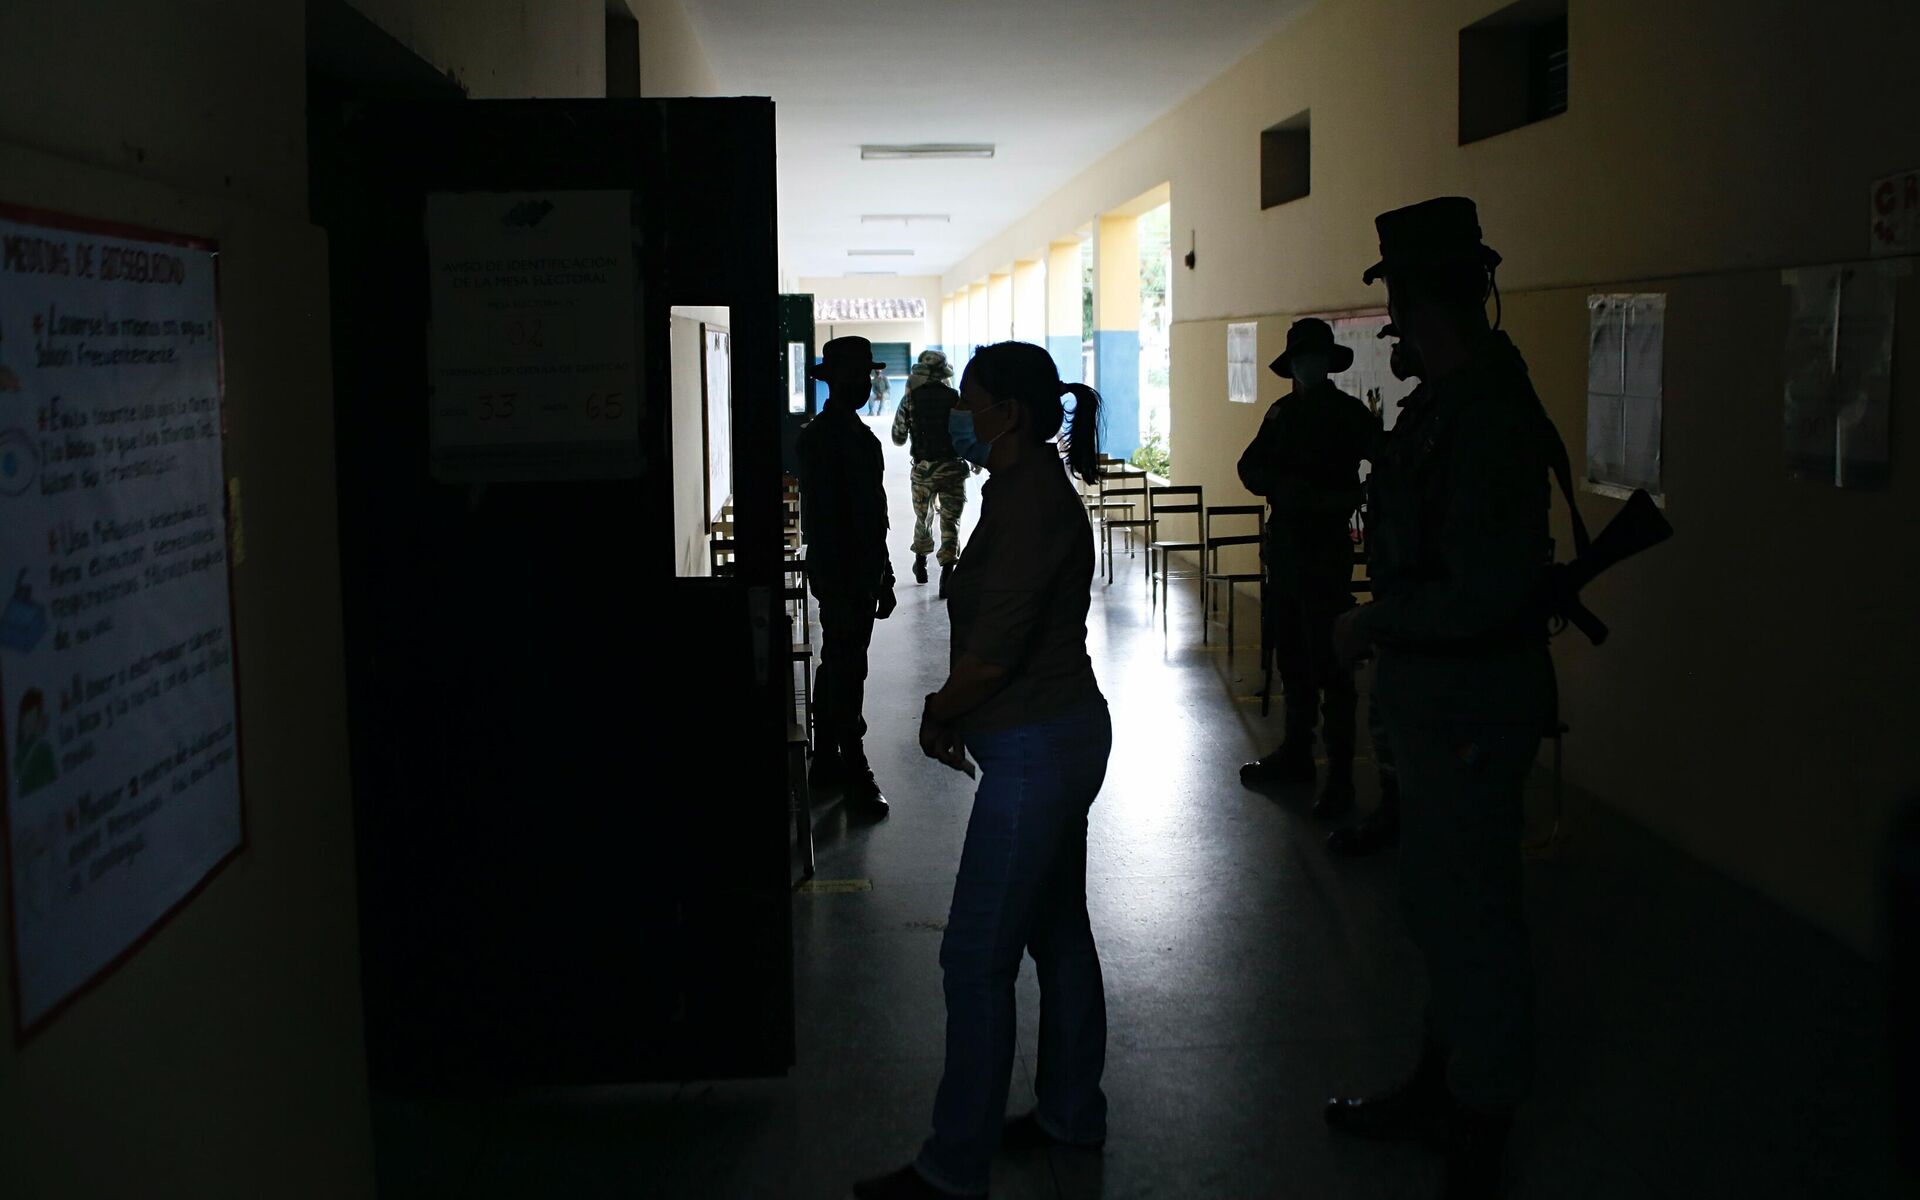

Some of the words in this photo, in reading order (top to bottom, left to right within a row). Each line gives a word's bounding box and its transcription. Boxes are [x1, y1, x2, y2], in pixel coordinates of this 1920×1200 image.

[4, 233, 70, 276] MEDIDAS
[76, 242, 94, 279] DE
[101, 244, 185, 286] BIOSEGURIDAD
[442, 261, 483, 274] AVISO
[487, 260, 505, 272] DE
[453, 277, 470, 289] DE
[472, 276, 493, 289] LA
[495, 275, 529, 288] MESA
[533, 271, 609, 286] ELECTORAL
[479, 391, 518, 421] 33
[585, 391, 625, 421] 65
